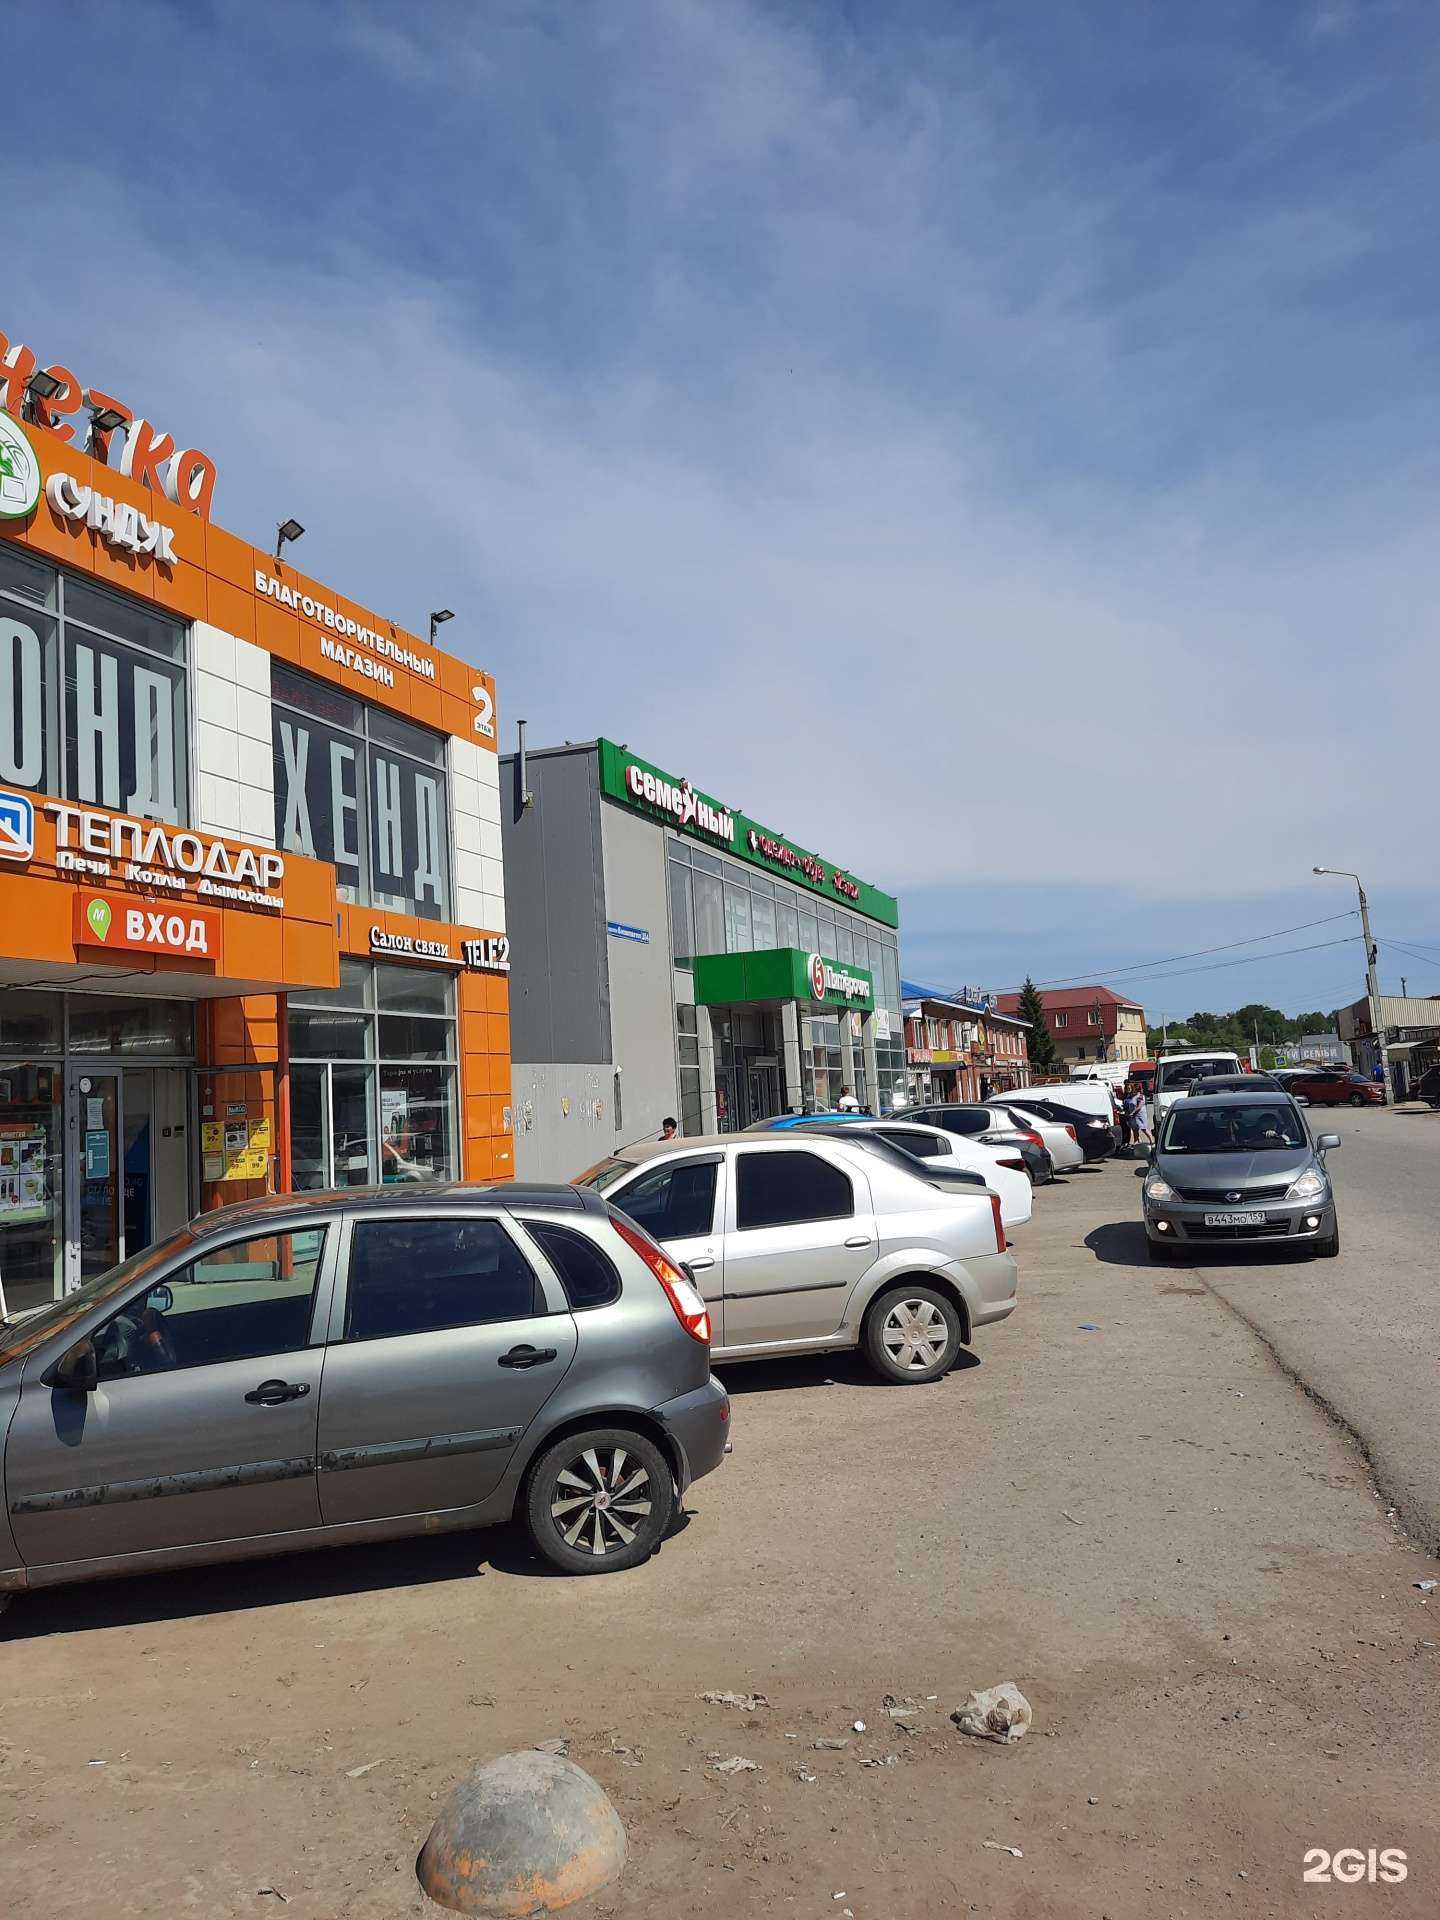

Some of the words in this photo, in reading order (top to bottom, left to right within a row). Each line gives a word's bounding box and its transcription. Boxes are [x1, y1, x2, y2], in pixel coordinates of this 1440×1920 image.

[255, 569, 436, 681] БЛАГОТВОРИТЕЛЬНЫЙ
[319, 636, 394, 689] МАГАЗИН
[471, 686, 494, 738] 2
[279, 720, 443, 905] ХЕНД
[44, 802, 285, 888] ТЕПЛОДАР
[56, 851, 111, 876] Печи
[125, 863, 186, 890] Котлы
[198, 878, 285, 909] Дымоходы
[126, 909, 208, 954] ВХОД
[370, 925, 413, 951] Салон
[415, 938, 449, 958] связи
[463, 936, 511, 971] TELE2
